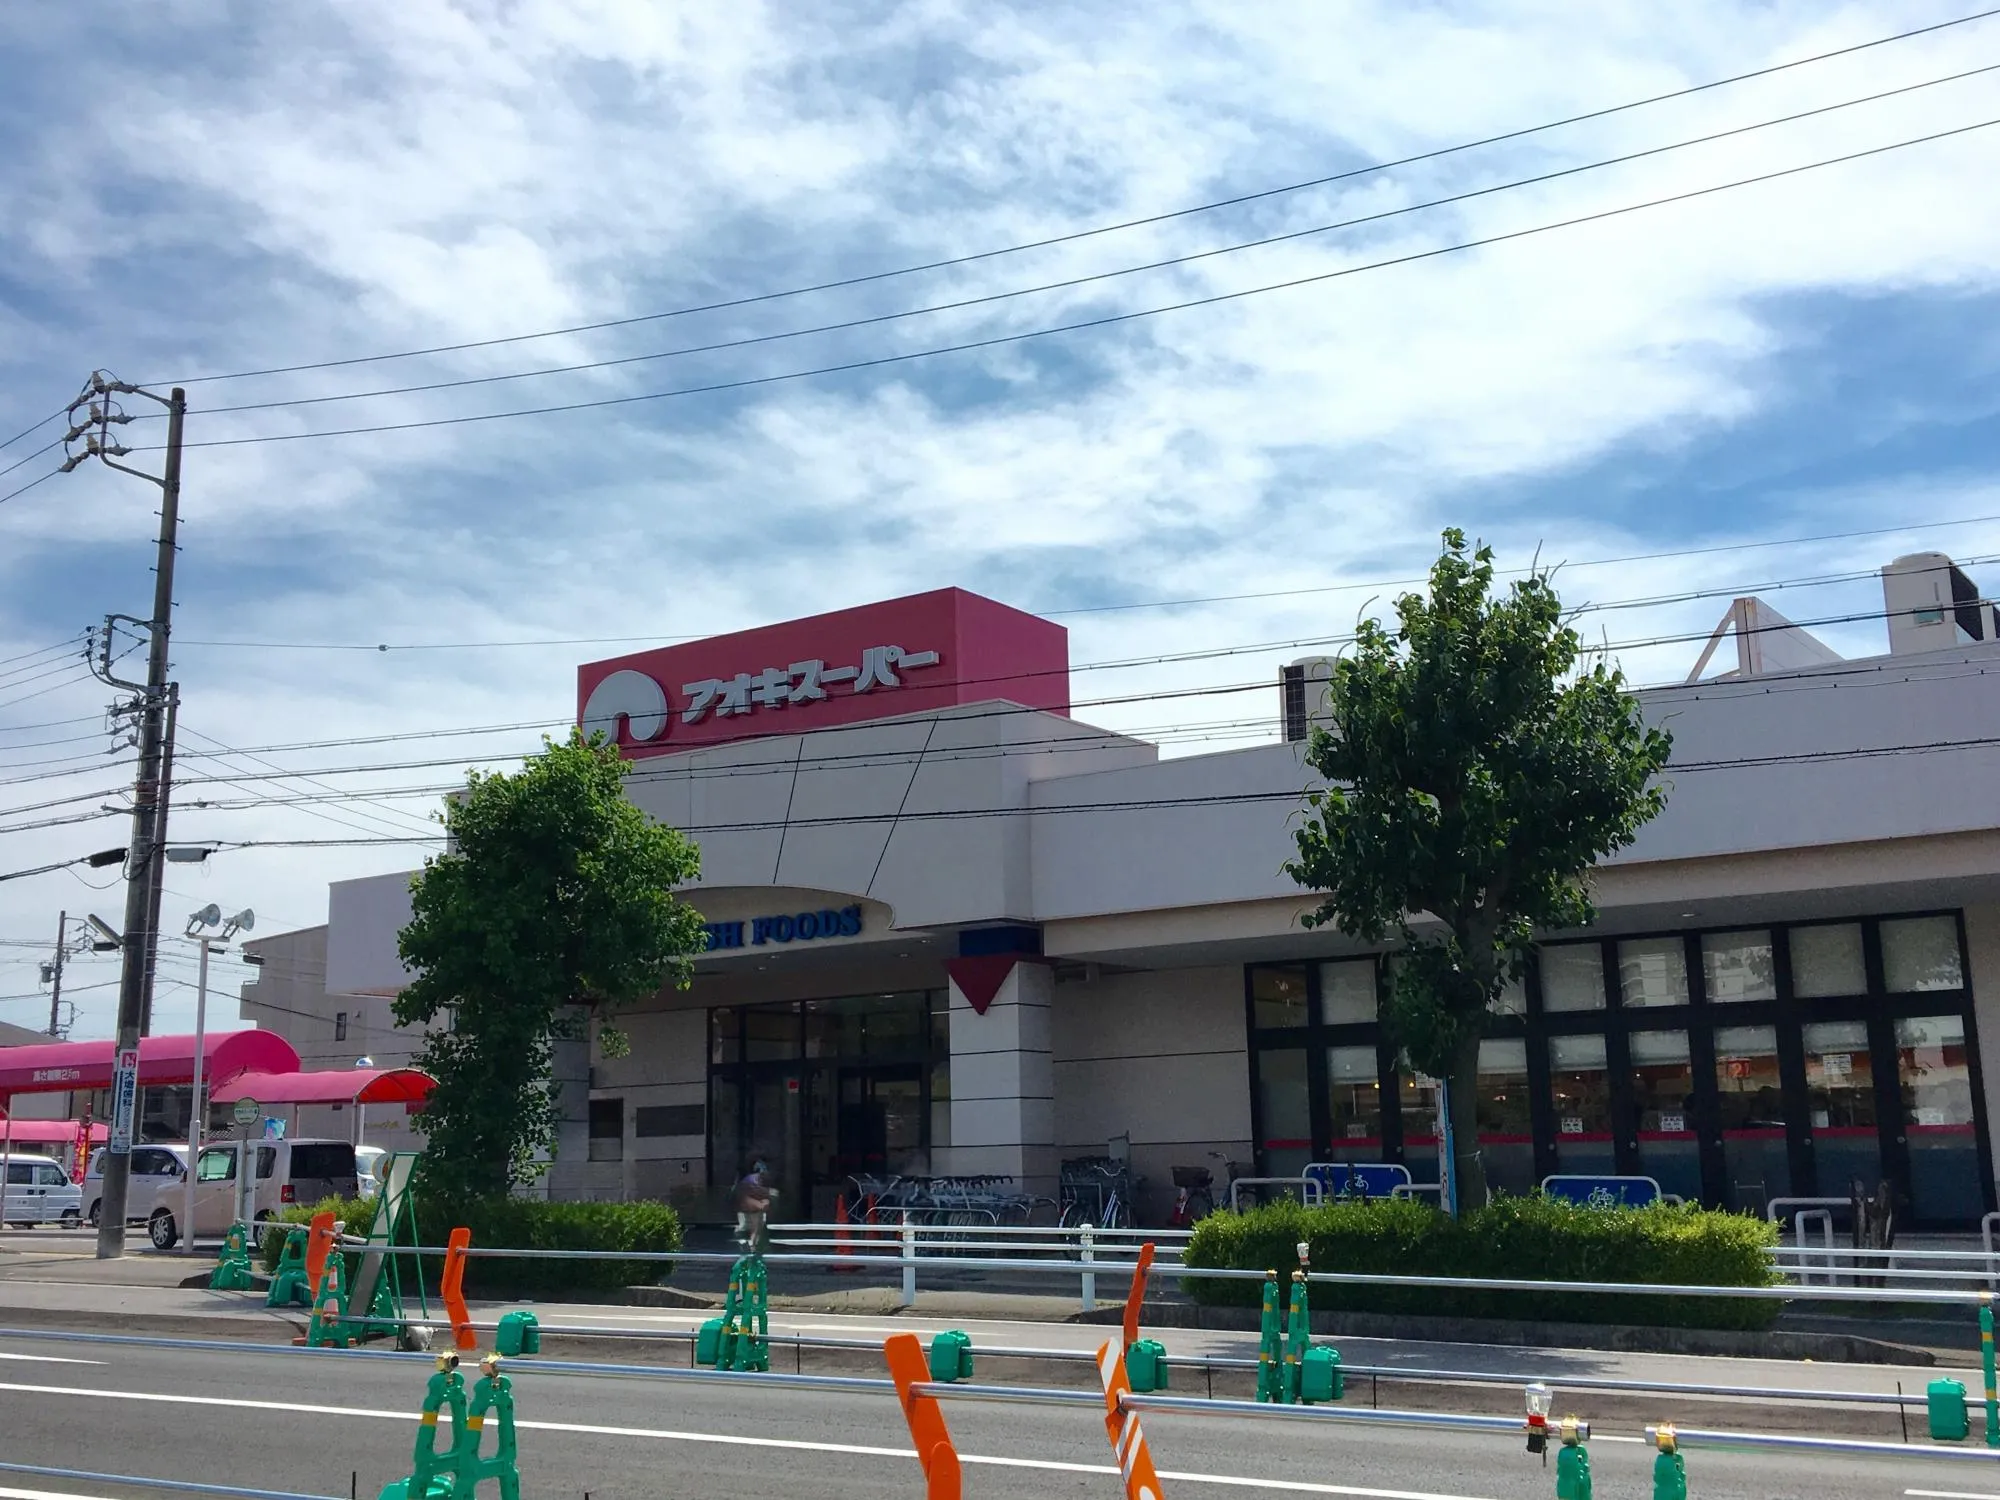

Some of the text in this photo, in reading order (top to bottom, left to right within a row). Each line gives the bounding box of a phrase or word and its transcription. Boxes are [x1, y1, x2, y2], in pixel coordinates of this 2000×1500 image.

[682, 645, 940, 724] アオキスーパー
[751, 903, 863, 946] FOODS
